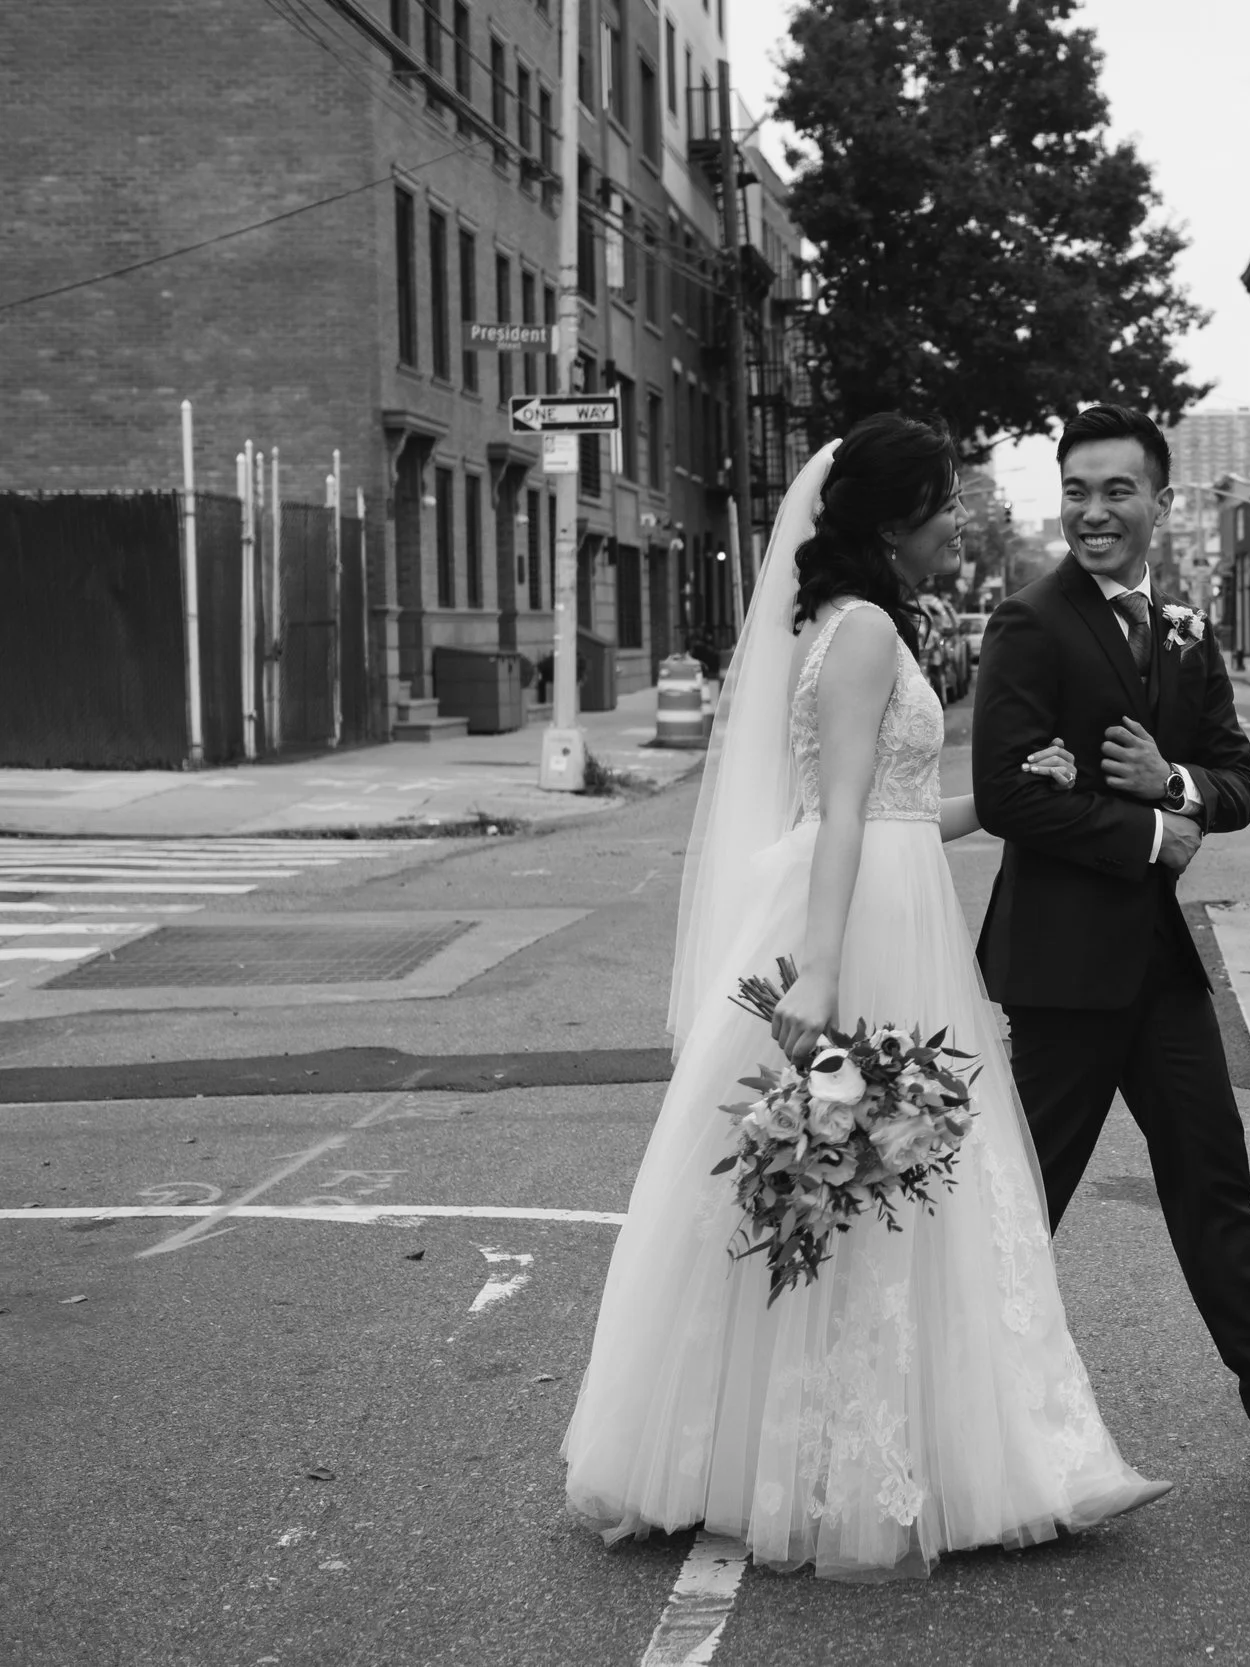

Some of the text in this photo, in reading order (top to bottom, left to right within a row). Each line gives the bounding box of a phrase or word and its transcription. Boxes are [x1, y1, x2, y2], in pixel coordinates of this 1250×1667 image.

[471, 324, 547, 343] President
[523, 406, 609, 422] ONE WAY
